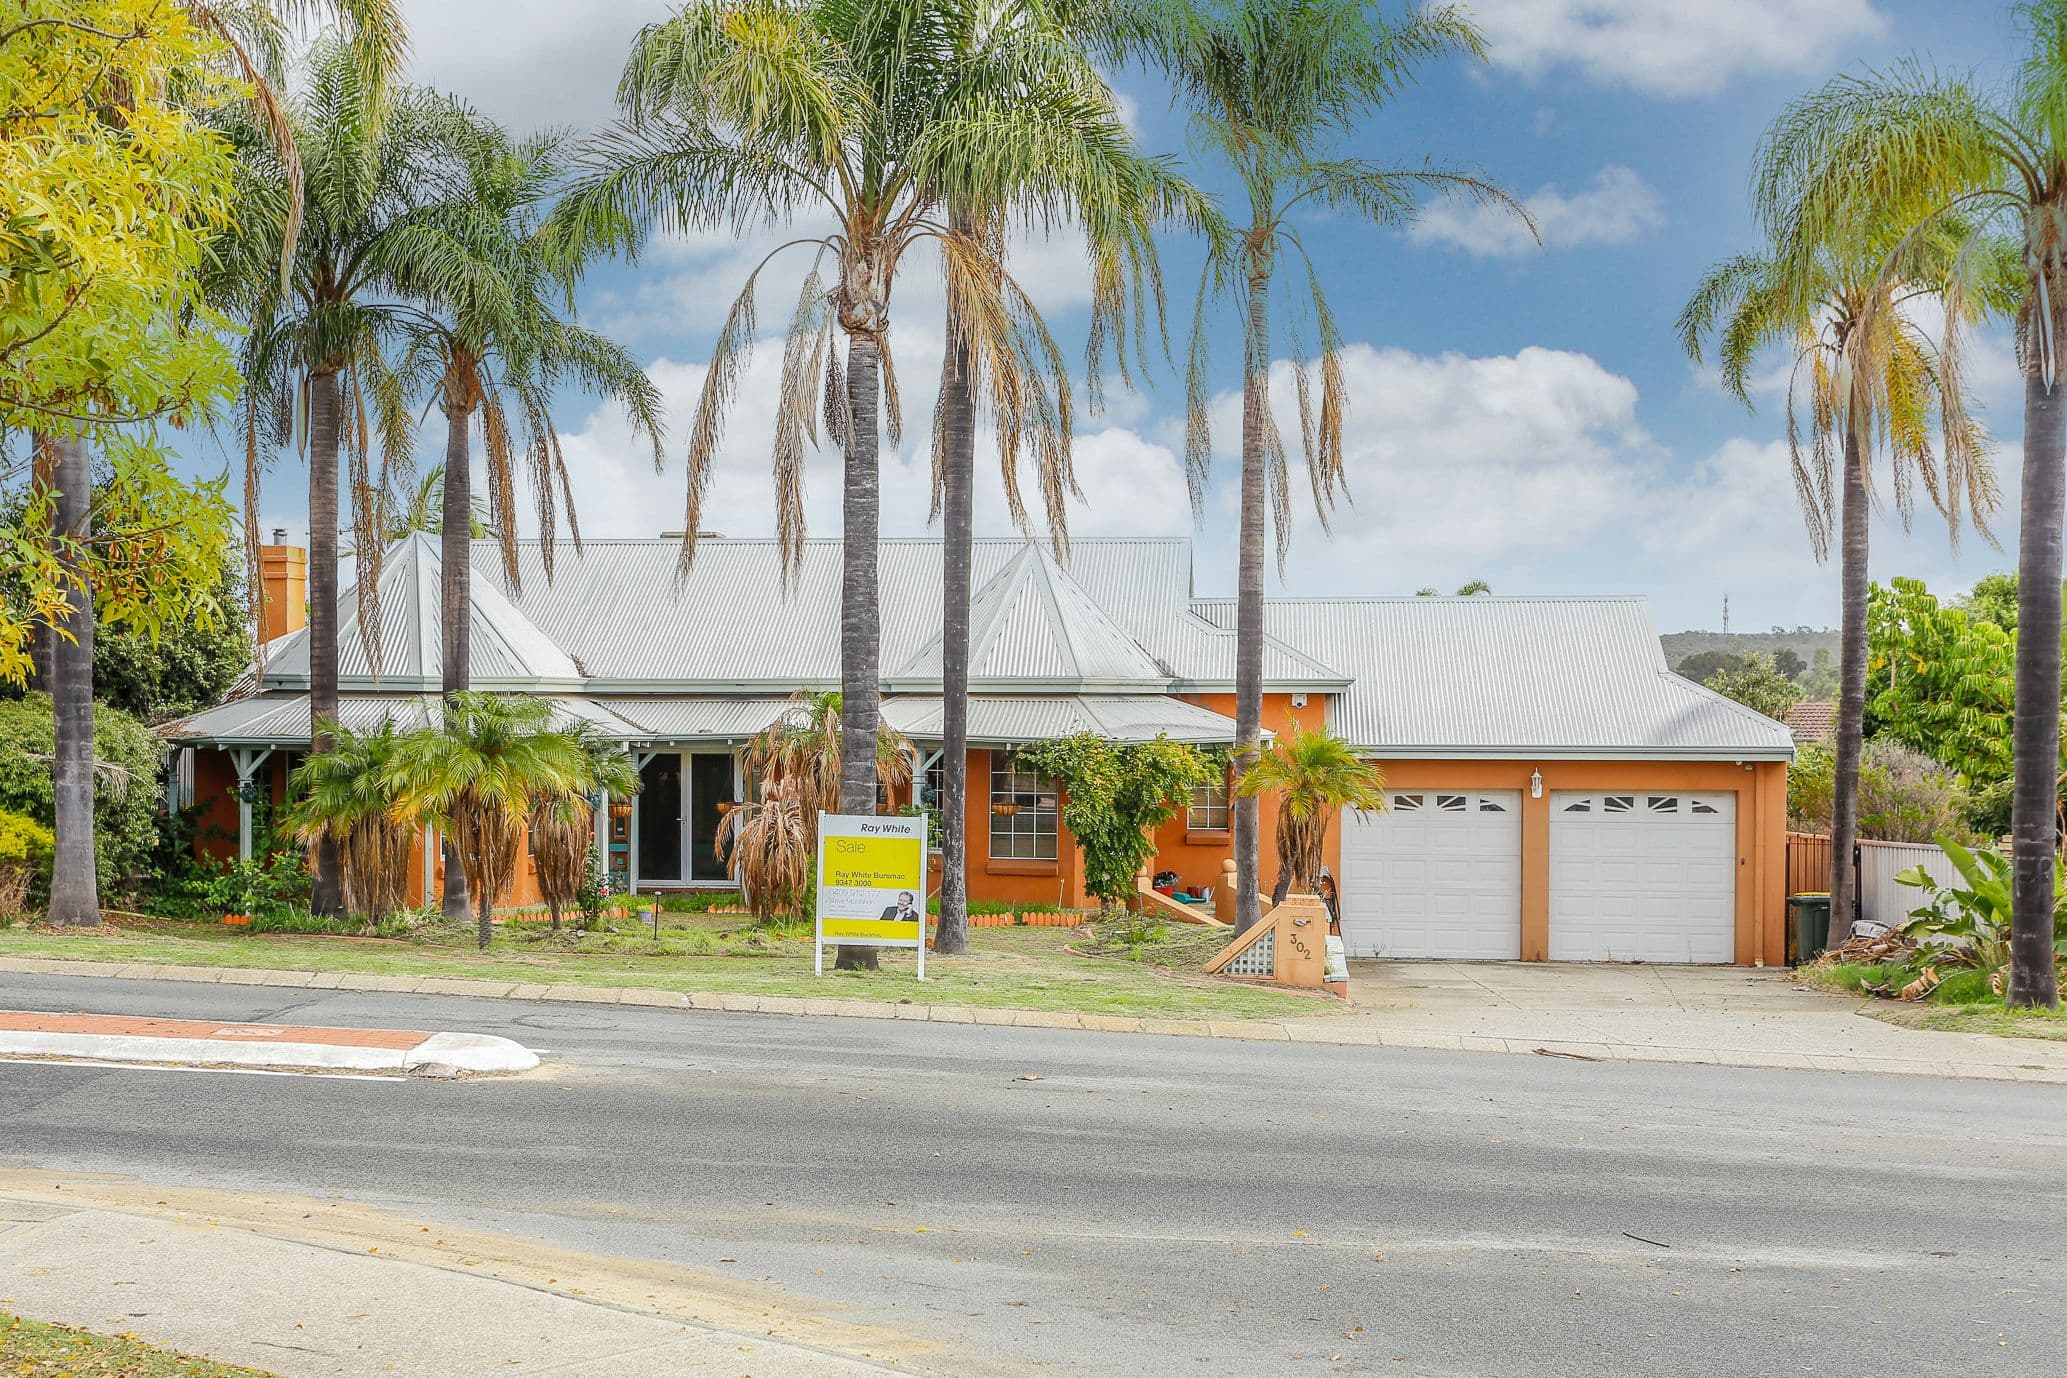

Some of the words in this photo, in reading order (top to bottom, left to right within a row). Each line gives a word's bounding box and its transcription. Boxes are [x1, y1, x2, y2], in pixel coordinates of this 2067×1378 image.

[860, 823, 881, 834] Ray
[882, 824, 911, 834] White
[836, 839, 866, 854] Sale
[835, 870, 850, 879] Ray
[851, 871, 872, 879] White
[873, 871, 906, 880] Bursmac
[1290, 934, 1311, 959] 302
